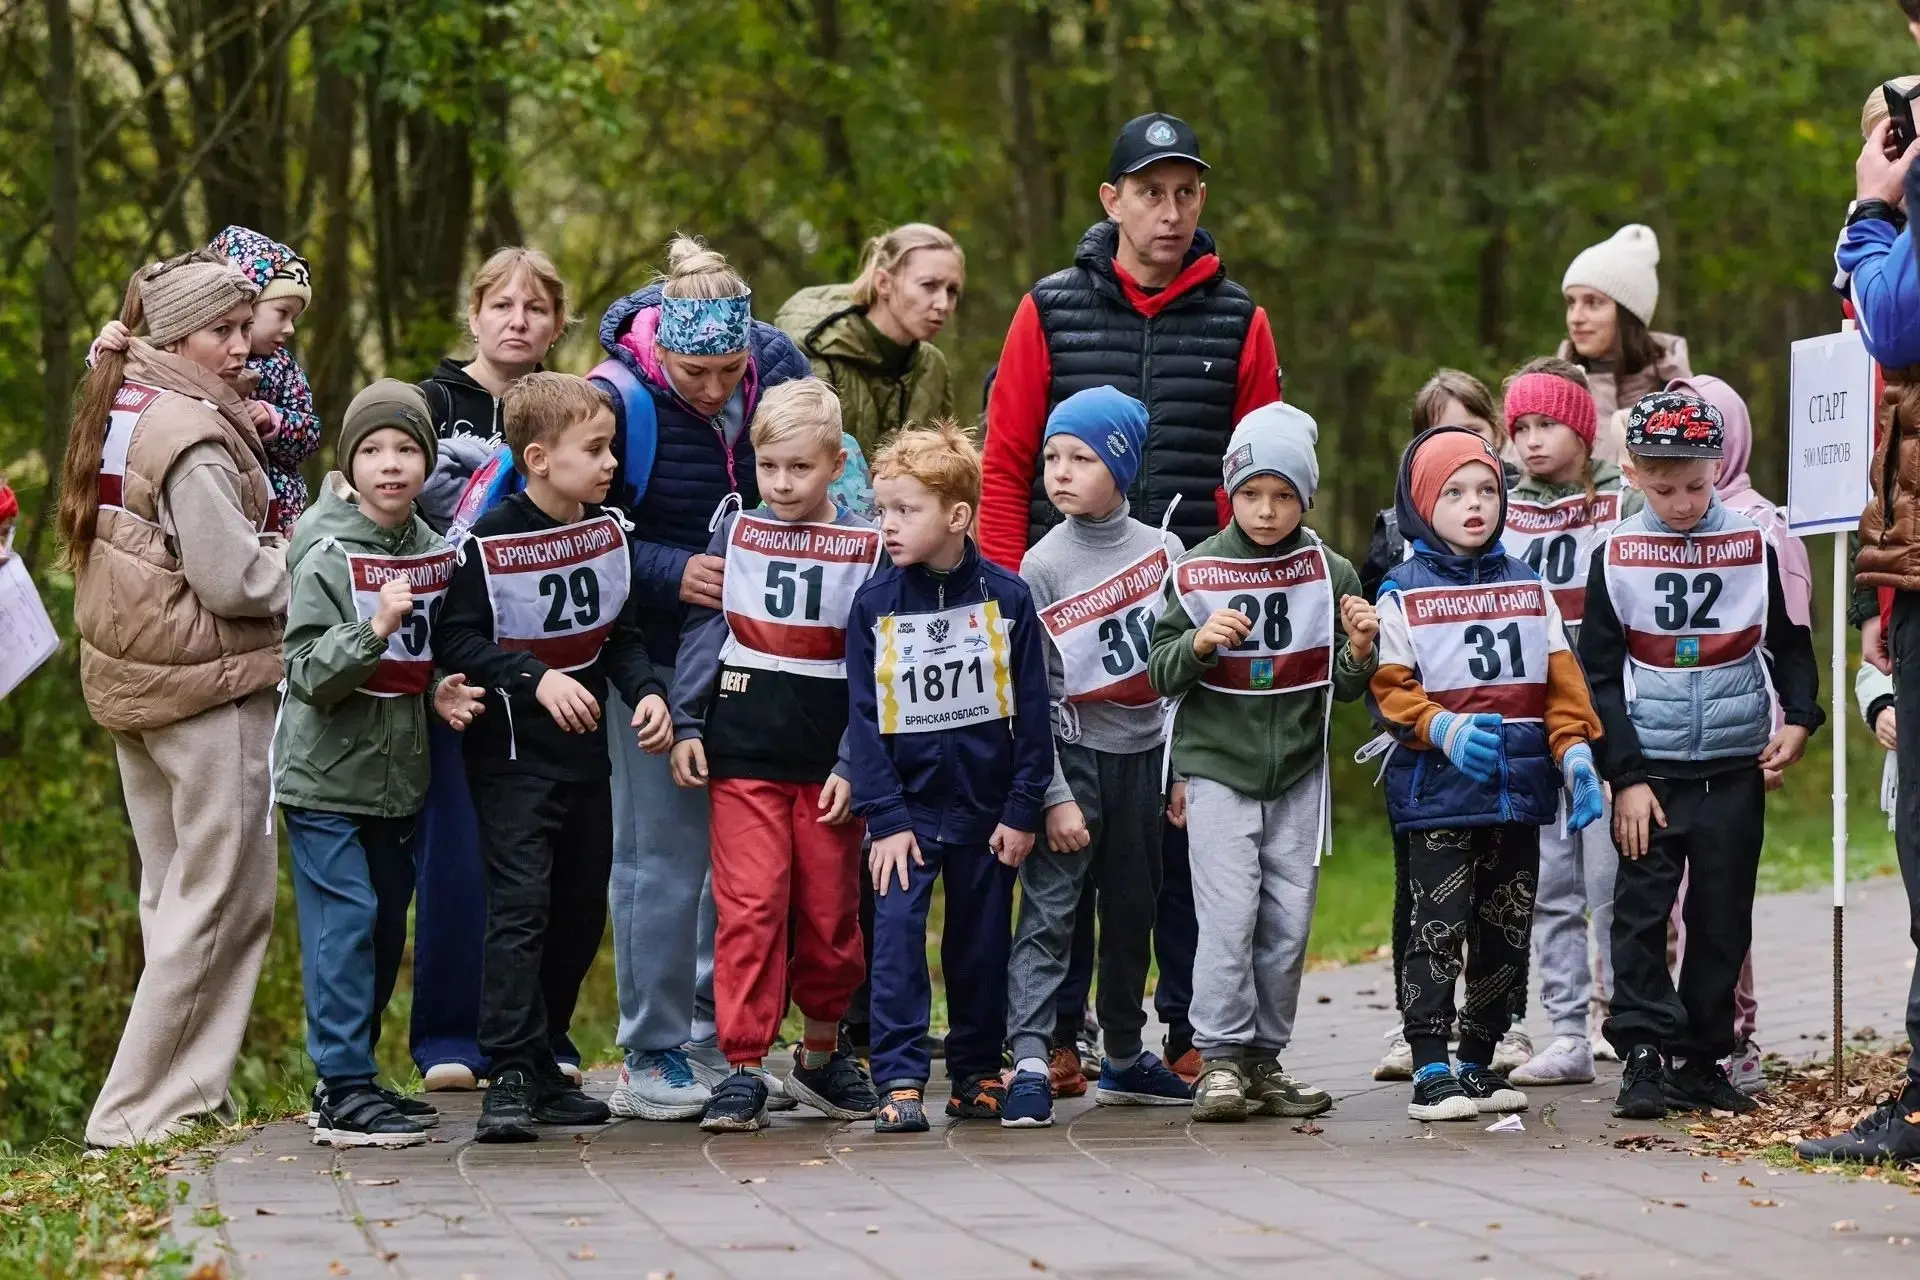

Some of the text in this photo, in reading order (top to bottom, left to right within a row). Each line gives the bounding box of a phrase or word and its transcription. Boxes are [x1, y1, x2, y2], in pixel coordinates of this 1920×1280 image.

[1809, 391, 1847, 424] СТАРТ
[1817, 442, 1851, 466] МЕТРОВ
[1568, 501, 1610, 523] РАОН
[496, 525, 614, 567] БРЯНСКИЙ РАЙОН
[741, 525, 868, 556] БРЯНСКИЙ РАЙОН
[1520, 534, 1577, 585] 40
[1619, 538, 1755, 565] БРЯНСКИЙ РАЙОН
[764, 560, 824, 621] 51
[1052, 559, 1164, 629] БРЯНСКИЙ РАЙОН
[1187, 566, 1273, 585] БРЯНСКИЙ
[539, 566, 601, 633] 29
[1227, 591, 1293, 651] 28
[1415, 589, 1542, 619] БРЯНСКИЙ РАЙОН
[1654, 572, 1723, 631] 32
[1098, 606, 1156, 676] 30
[1464, 622, 1526, 681] 31
[902, 656, 984, 703] 1871
[905, 705, 990, 726] БРЯНСКАЯ ОБЛАСТЬ
